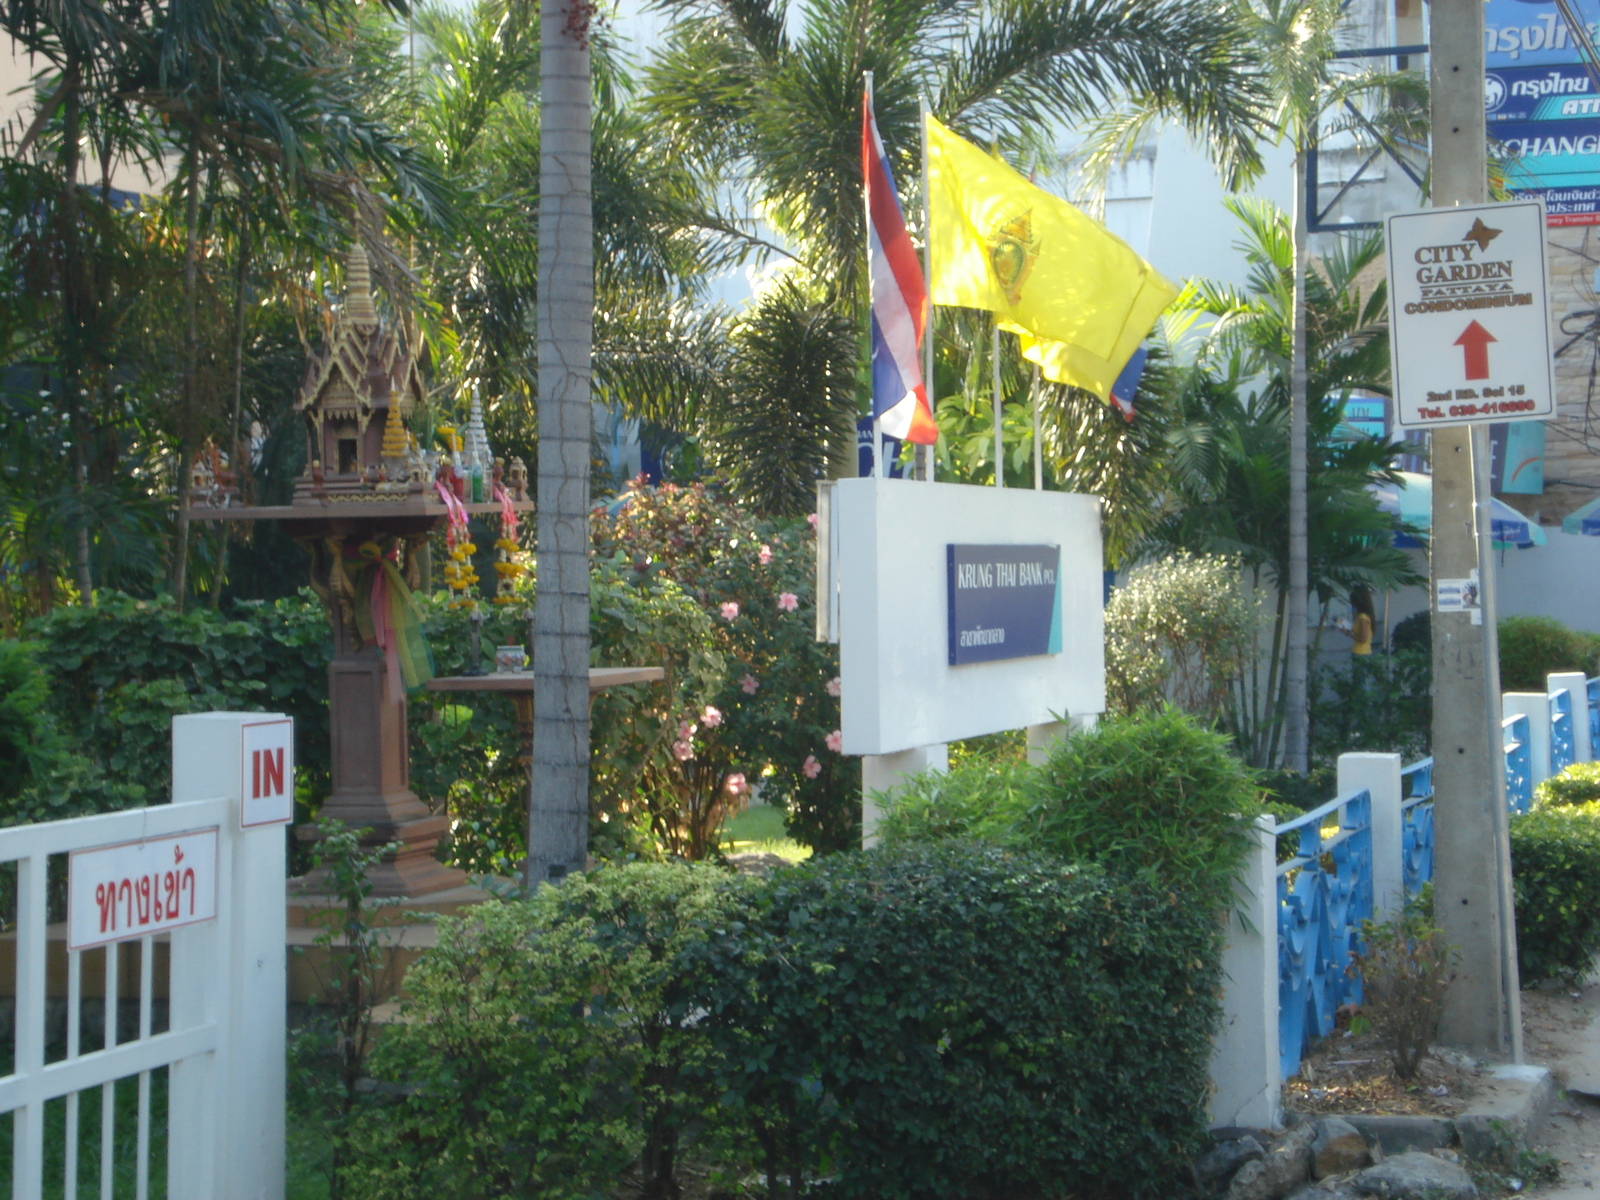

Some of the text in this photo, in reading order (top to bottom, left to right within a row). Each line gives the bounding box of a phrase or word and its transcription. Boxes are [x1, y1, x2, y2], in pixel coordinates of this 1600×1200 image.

[1511, 72, 1589, 99] กรุงไทย
[1487, 135, 1600, 159] XCHANG
[1415, 244, 1476, 264] CITY
[1416, 260, 1513, 284] GARDEN
[1420, 283, 1514, 297] PATTAYA
[1404, 293, 1532, 314] CONDOMINIUM
[958, 563, 993, 589] KRUNG
[996, 563, 1017, 587] THAI
[1019, 562, 1043, 587] BANK
[252, 747, 284, 799] IN
[95, 844, 195, 934] ทางเข้า
